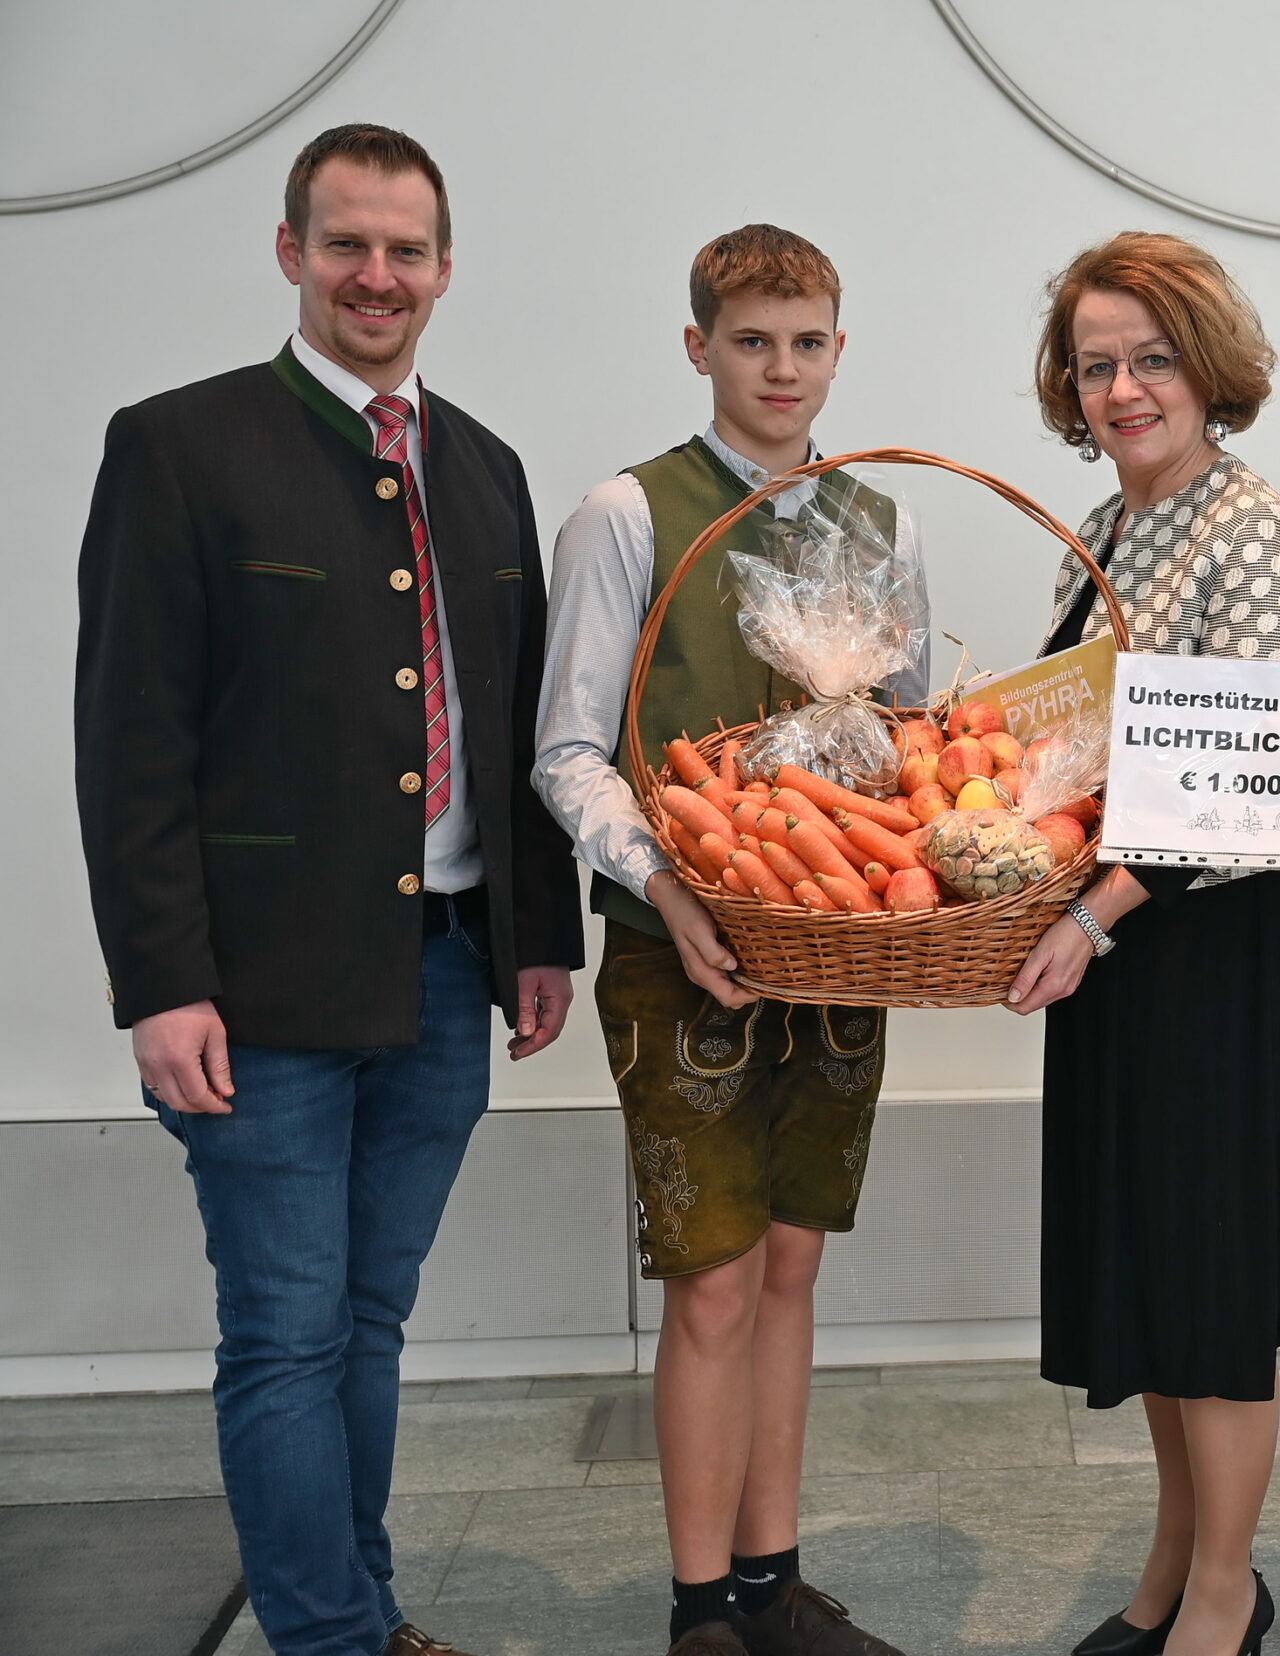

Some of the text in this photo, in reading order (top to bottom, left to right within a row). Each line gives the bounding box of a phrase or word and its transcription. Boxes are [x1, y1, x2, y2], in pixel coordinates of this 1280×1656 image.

[1000, 664, 1084, 706] Bildungszentrum
[1005, 677, 1096, 736] PYHRA
[1180, 771, 1197, 792] €
